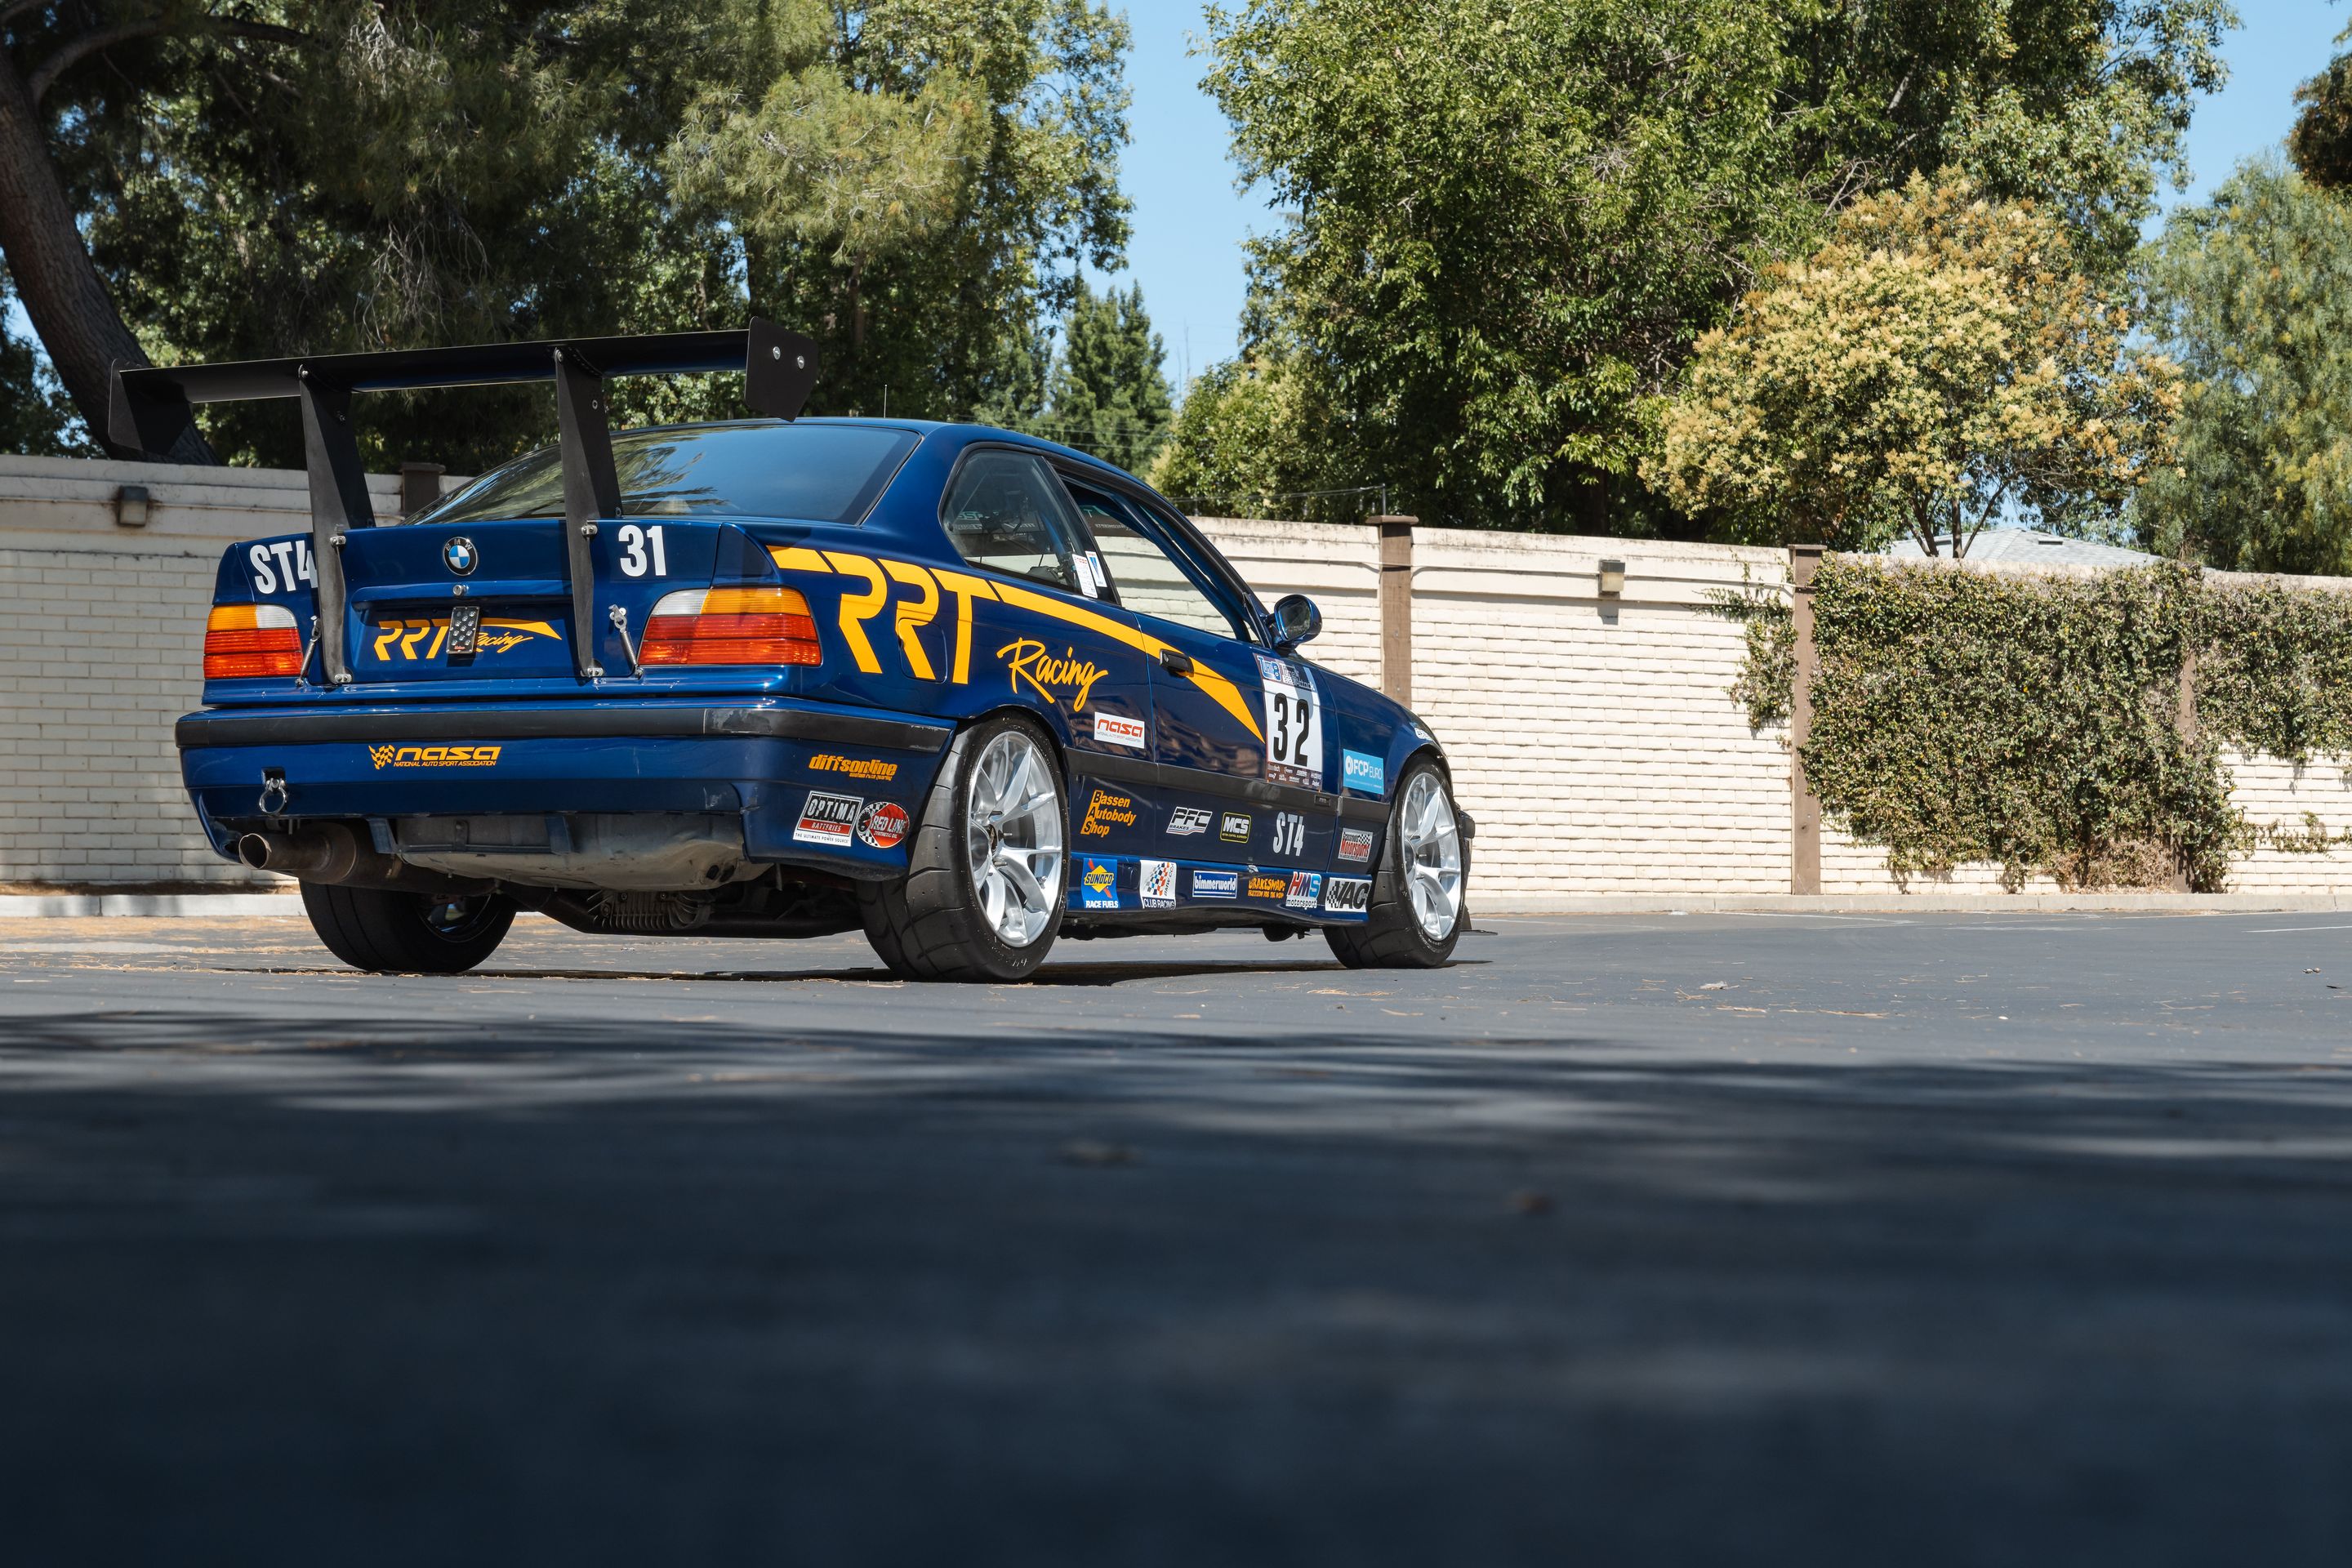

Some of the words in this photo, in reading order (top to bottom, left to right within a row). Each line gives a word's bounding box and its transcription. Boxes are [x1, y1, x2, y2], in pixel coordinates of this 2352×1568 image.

[618, 524, 666, 577] 31
[249, 540, 318, 594] ST4
[820, 550, 1000, 684] RRT
[996, 637, 1108, 711] Racing
[1097, 719, 1143, 738] nasa
[1273, 693, 1310, 767] 32
[395, 746, 501, 761] nasa
[808, 754, 898, 776] diffsonline
[1353, 759, 1369, 777] FCP
[1093, 791, 1131, 808] Bassen
[807, 799, 857, 822] OPTIMA
[1088, 806, 1137, 826] Autobody
[1172, 808, 1212, 827] PFC
[812, 822, 842, 832] BATTERIES
[871, 815, 889, 831] RED
[1084, 820, 1111, 838] Shop
[1223, 816, 1250, 835] MCS
[1273, 812, 1305, 856] ST4
[1085, 874, 1113, 884] SUNOCO
[1194, 875, 1236, 891] bimmerworld
[1288, 871, 1321, 898] HMS
[1085, 900, 1102, 908] RACE
[1102, 900, 1119, 908] FUELS
[1287, 898, 1316, 908] motorsport
[1327, 880, 1370, 909] VAC
[1144, 898, 1157, 908] CLUB
[1157, 899, 1175, 911] RACING
